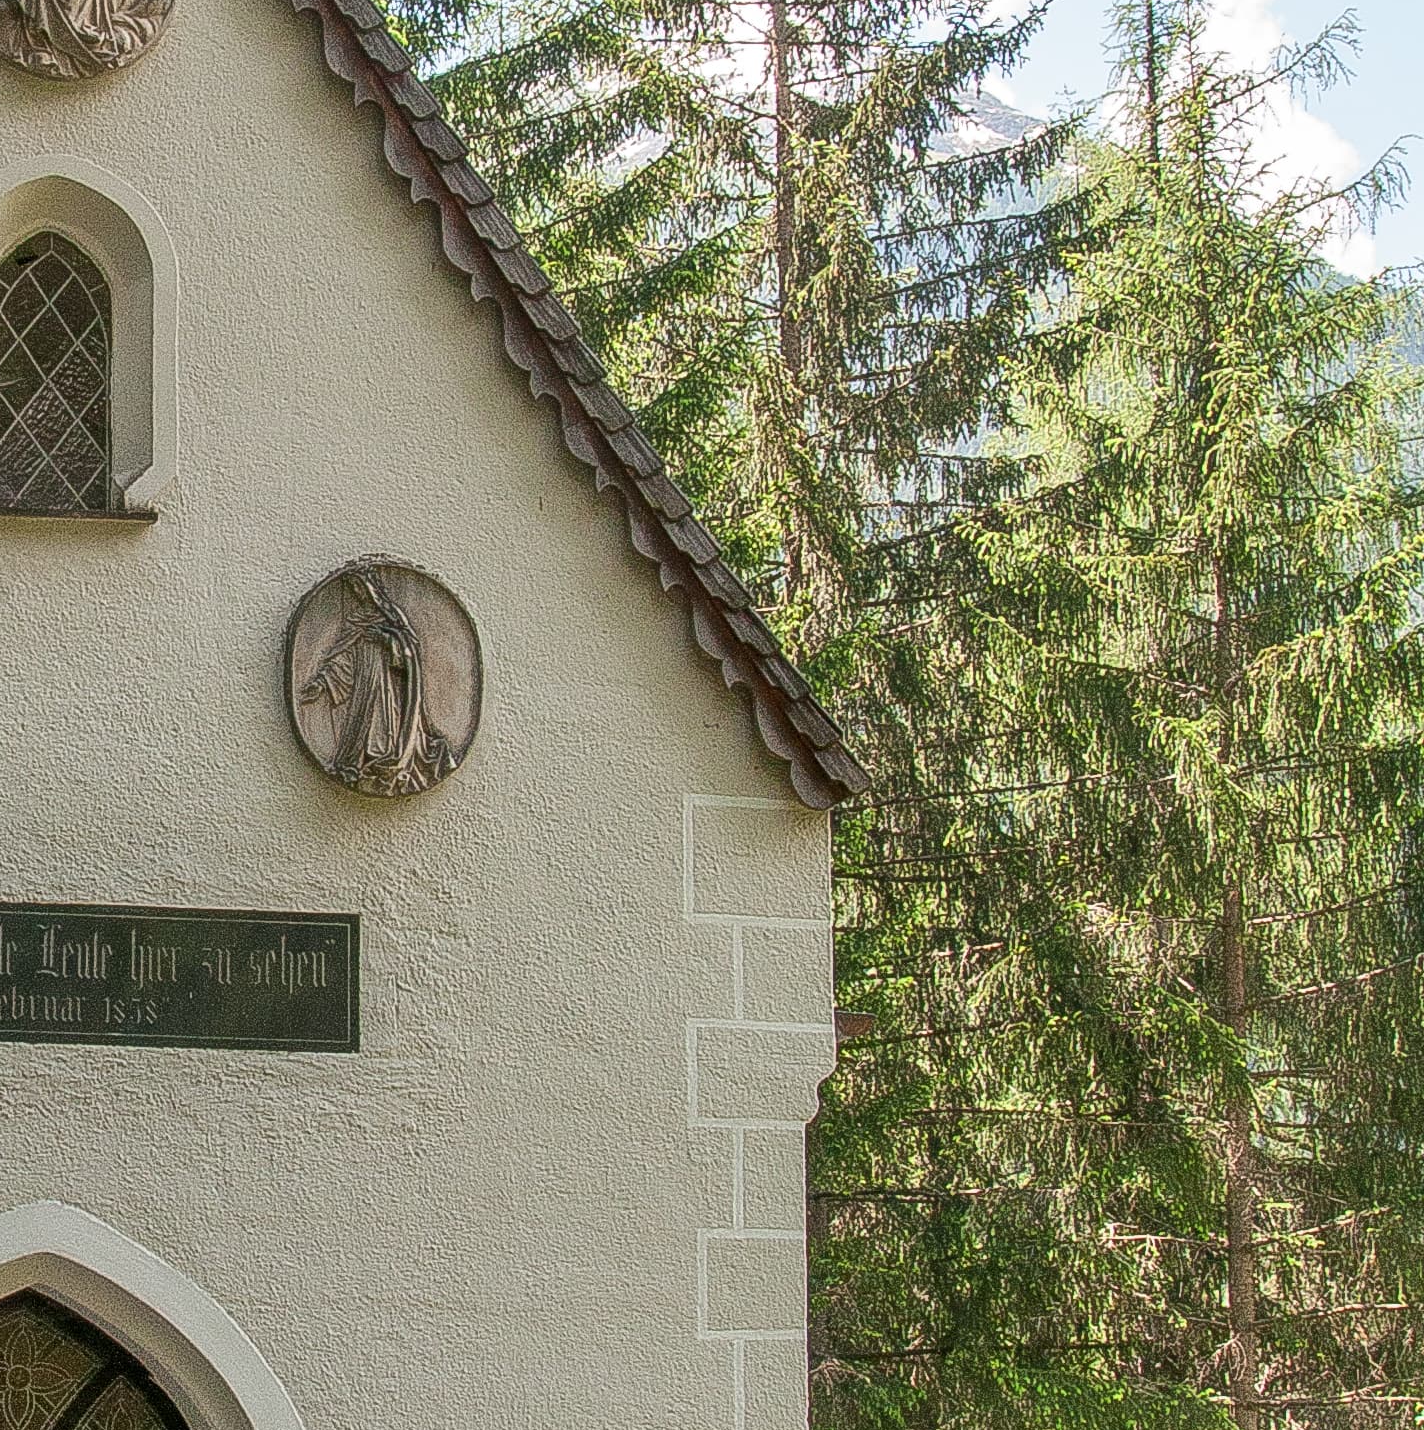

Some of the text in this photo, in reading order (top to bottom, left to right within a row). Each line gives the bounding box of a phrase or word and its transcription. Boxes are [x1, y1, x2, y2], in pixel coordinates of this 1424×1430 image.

[36, 923, 114, 980] Leute
[131, 927, 182, 991] hier
[200, 946, 233, 985] zu
